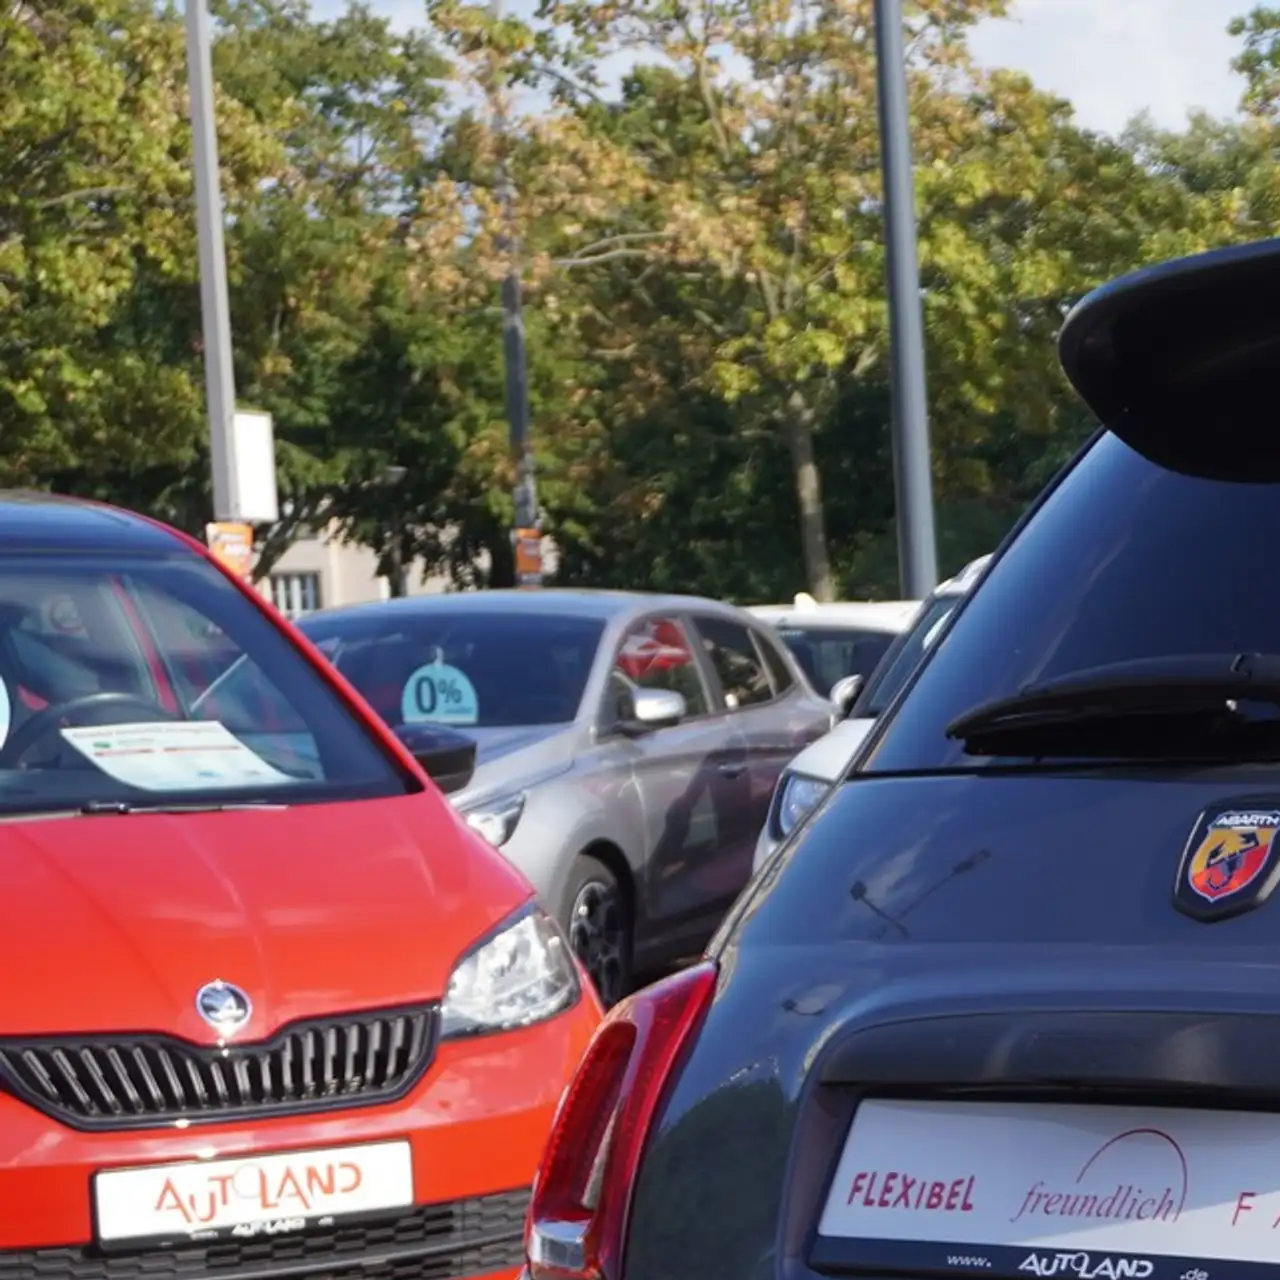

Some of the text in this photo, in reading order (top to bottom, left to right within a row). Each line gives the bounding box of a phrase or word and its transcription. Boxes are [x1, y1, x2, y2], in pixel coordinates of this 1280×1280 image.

[415, 676, 463, 715] 0%
[1216, 813, 1280, 827] ABARTH
[154, 1161, 363, 1224] AUTOLAND
[848, 1171, 976, 1212] FLEXIBEL
[1009, 1180, 1175, 1224] freundlich
[1018, 1252, 1155, 1280] AUTOLAND
